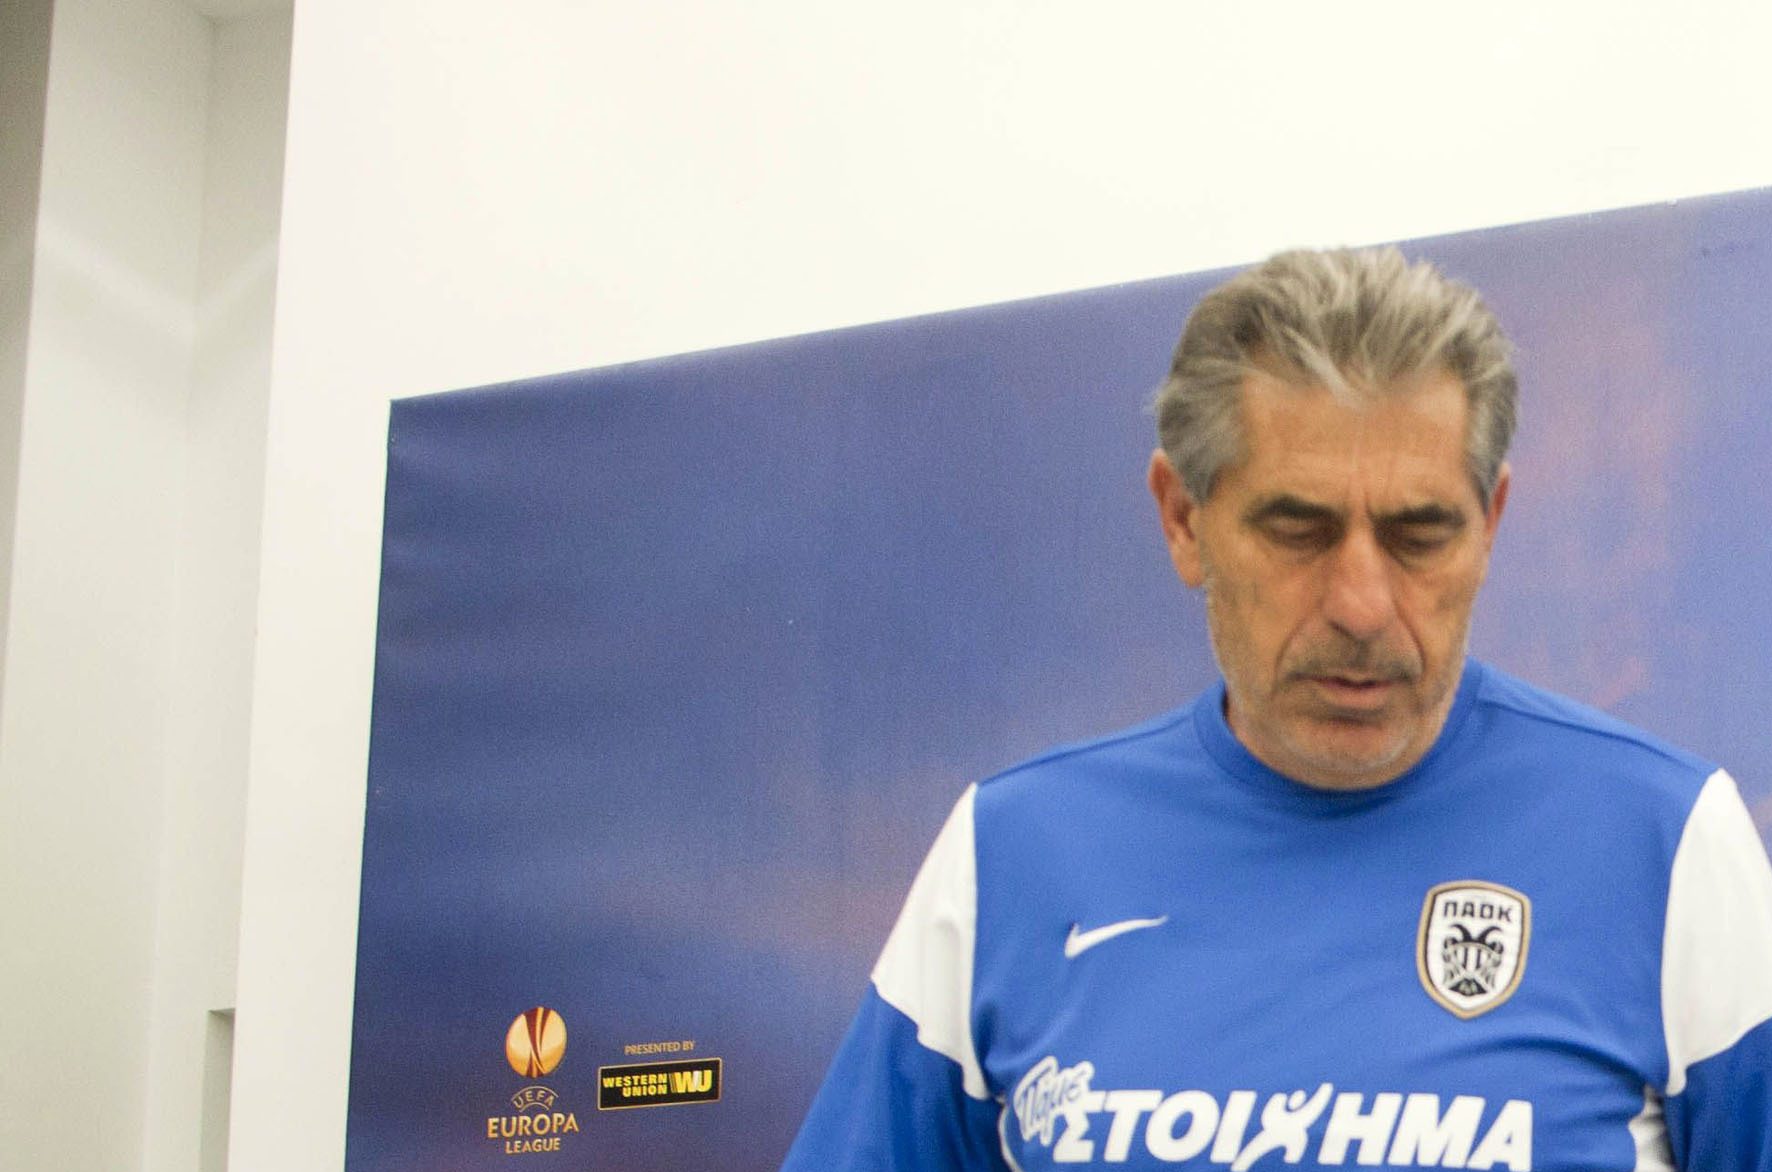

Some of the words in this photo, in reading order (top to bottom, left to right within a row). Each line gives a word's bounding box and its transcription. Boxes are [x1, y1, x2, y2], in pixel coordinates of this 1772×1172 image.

[624, 1042, 677, 1056] PRESENTED
[602, 1074, 667, 1088] WESTERN
[674, 1069, 712, 1094] WU
[513, 1087, 556, 1110] UEFA
[622, 1084, 667, 1098] UNION
[487, 1112, 579, 1139] EUROPA
[506, 1136, 560, 1154] LEAGUE
